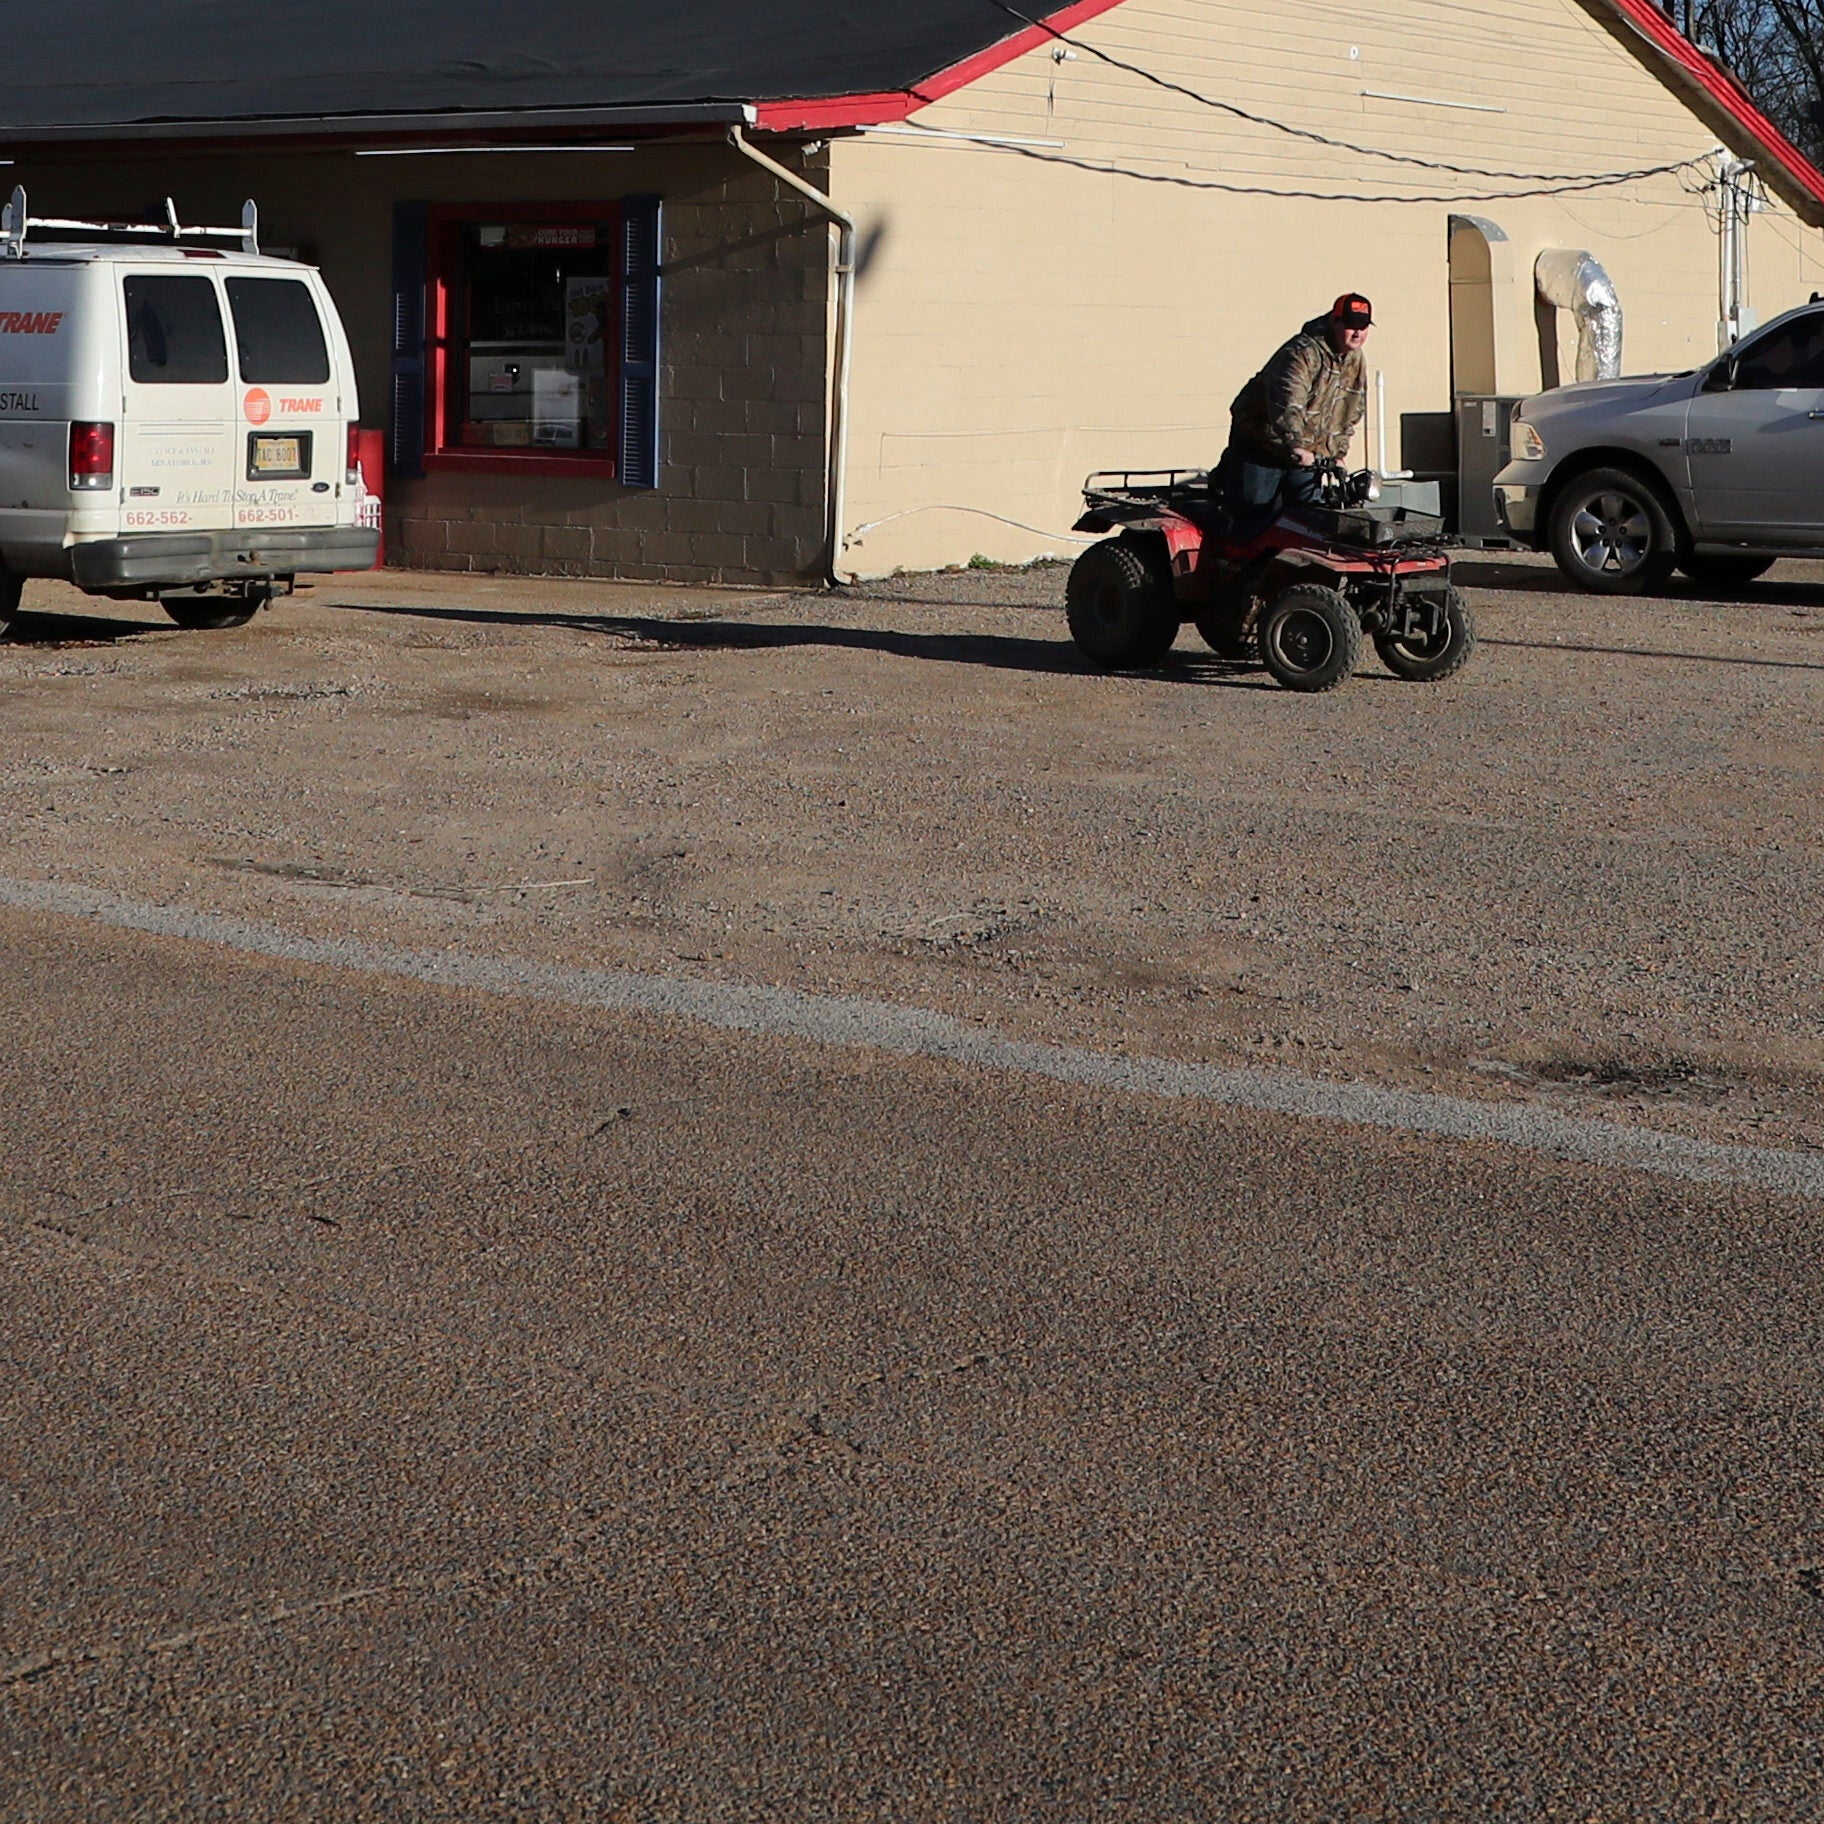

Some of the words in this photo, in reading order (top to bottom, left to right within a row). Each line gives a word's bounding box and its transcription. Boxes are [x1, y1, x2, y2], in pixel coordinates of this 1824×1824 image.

[279, 398, 323, 412] TRANE
[192, 489, 220, 504] Hard
[236, 489, 258, 506] Stop
[258, 489, 269, 503] A
